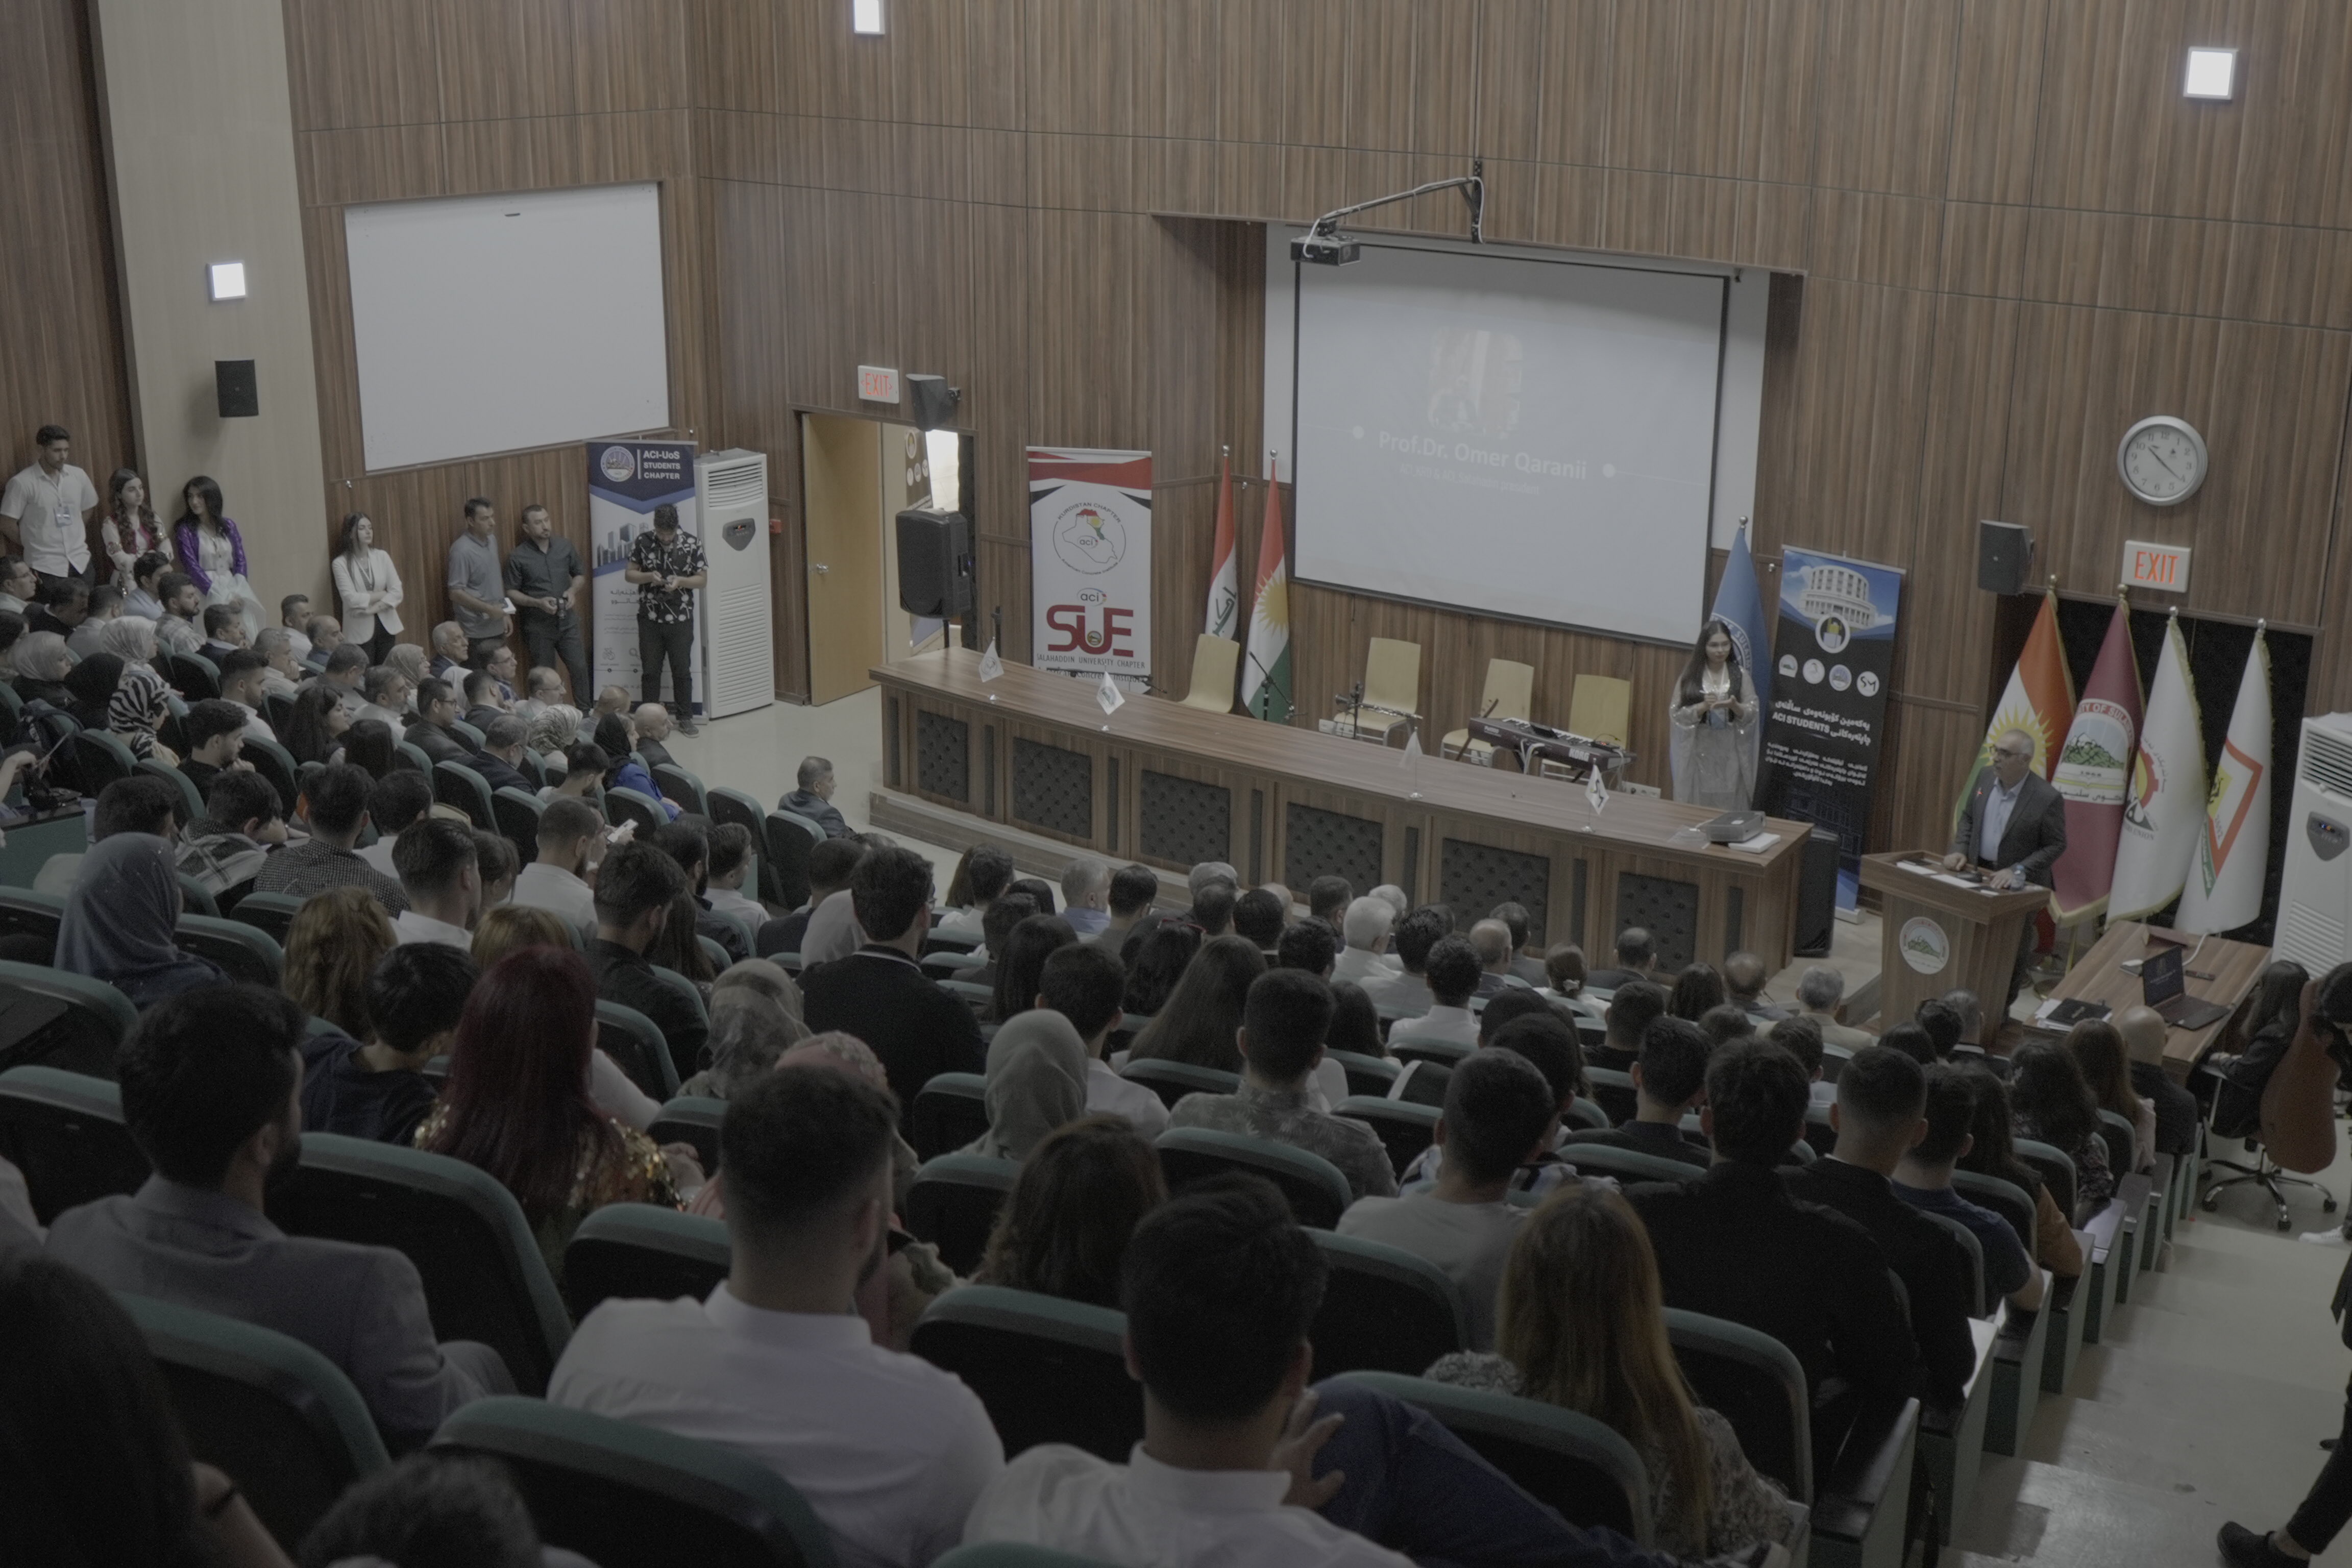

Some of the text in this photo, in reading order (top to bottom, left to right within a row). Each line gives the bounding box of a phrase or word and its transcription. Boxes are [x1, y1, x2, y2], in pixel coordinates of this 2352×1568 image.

[865, 373, 889, 397] EXIT
[2148, 433, 2154, 442] 11
[2161, 431, 2170, 440] 12
[2136, 442, 2145, 450] 10
[2176, 437, 2180, 445] 1
[643, 450, 680, 459] ACI-UoS
[1379, 431, 1587, 480] Prof.Dr. Omer Qaranii
[2132, 453, 2138, 461] 9
[2134, 465, 2139, 474] 8
[2169, 482, 2175, 491] 5
[1058, 502, 1121, 524] KURDISTAN CHAPTER
[2135, 551, 2180, 584] EXIT
[1080, 592, 1099, 602] aci
[1036, 653, 1145, 669] SALAHADDIN UNIVERSITY CHAPTER
[2092, 703, 2108, 713] OF
[1772, 712, 1830, 734] ACI STUDENTS
[1569, 748, 1590, 762] KORG
